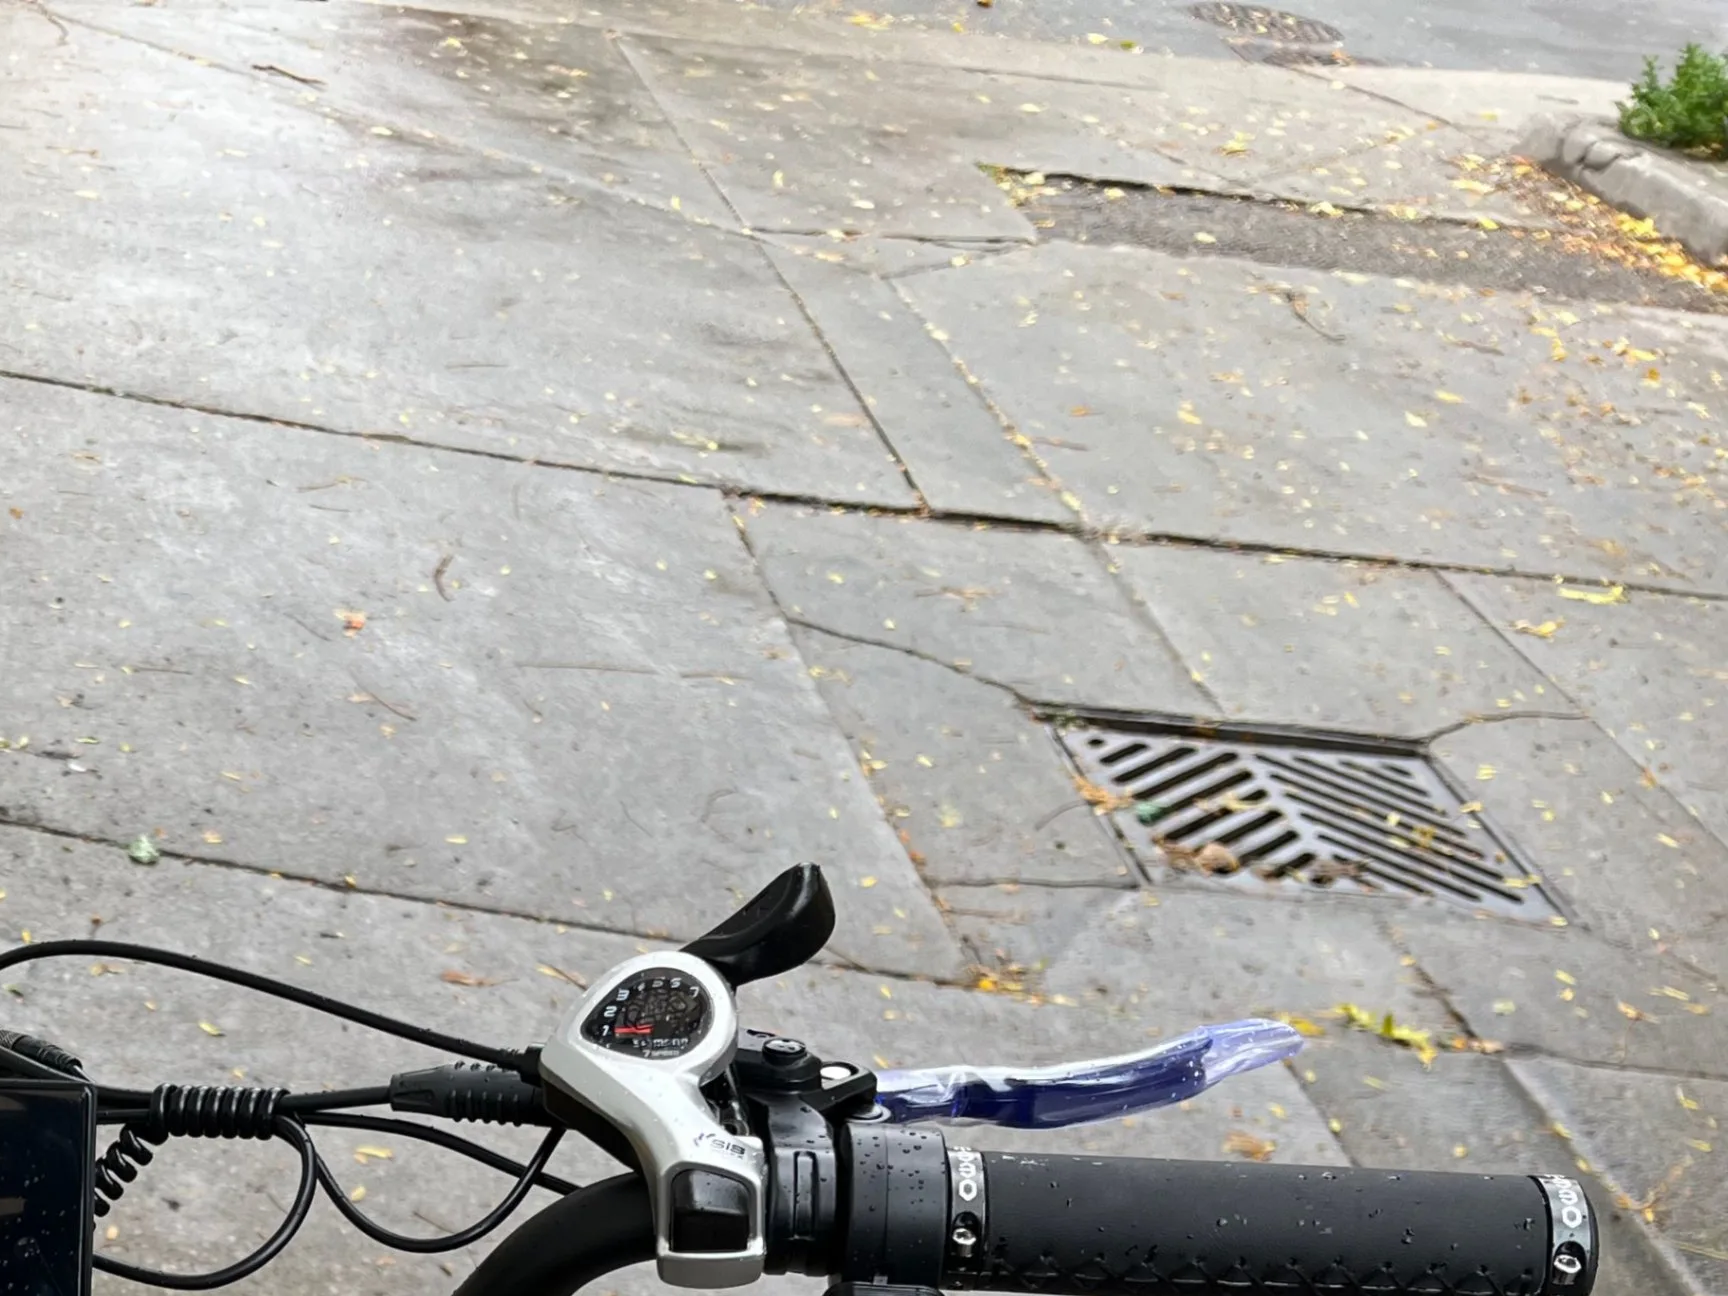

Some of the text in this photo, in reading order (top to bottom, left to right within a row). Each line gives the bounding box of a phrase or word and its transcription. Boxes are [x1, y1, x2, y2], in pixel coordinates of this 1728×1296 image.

[616, 989, 630, 1001] 3
[689, 986, 700, 998] 7
[603, 1005, 617, 1017] 2
[602, 1025, 610, 1036] 1
[642, 1050, 650, 1058] 7
